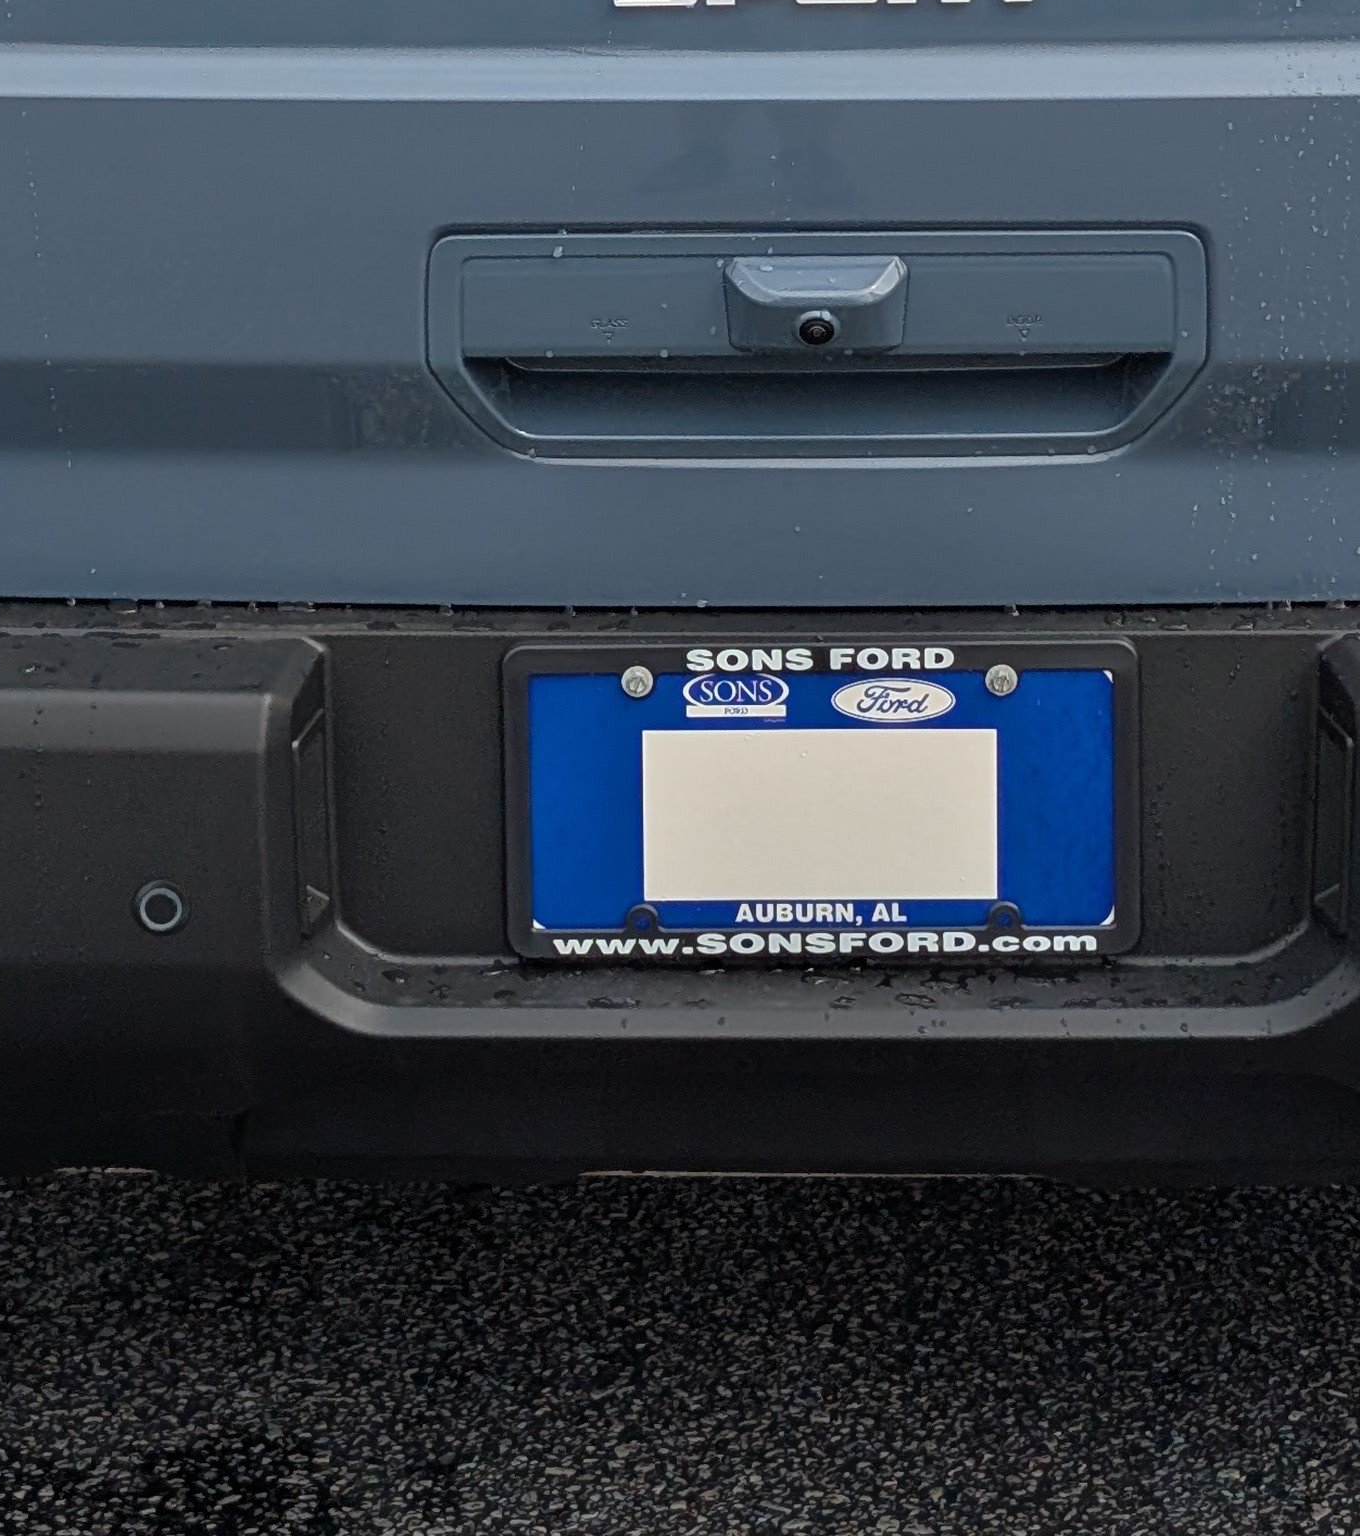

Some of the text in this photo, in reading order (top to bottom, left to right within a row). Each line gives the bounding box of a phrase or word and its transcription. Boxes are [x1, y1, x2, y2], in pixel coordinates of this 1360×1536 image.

[685, 648, 955, 672] SONS FORD
[700, 680, 772, 702] SONS
[856, 685, 930, 714] Ford
[735, 903, 908, 926] AUBURN, AL
[554, 930, 1098, 955] www.SONSFORD.com
